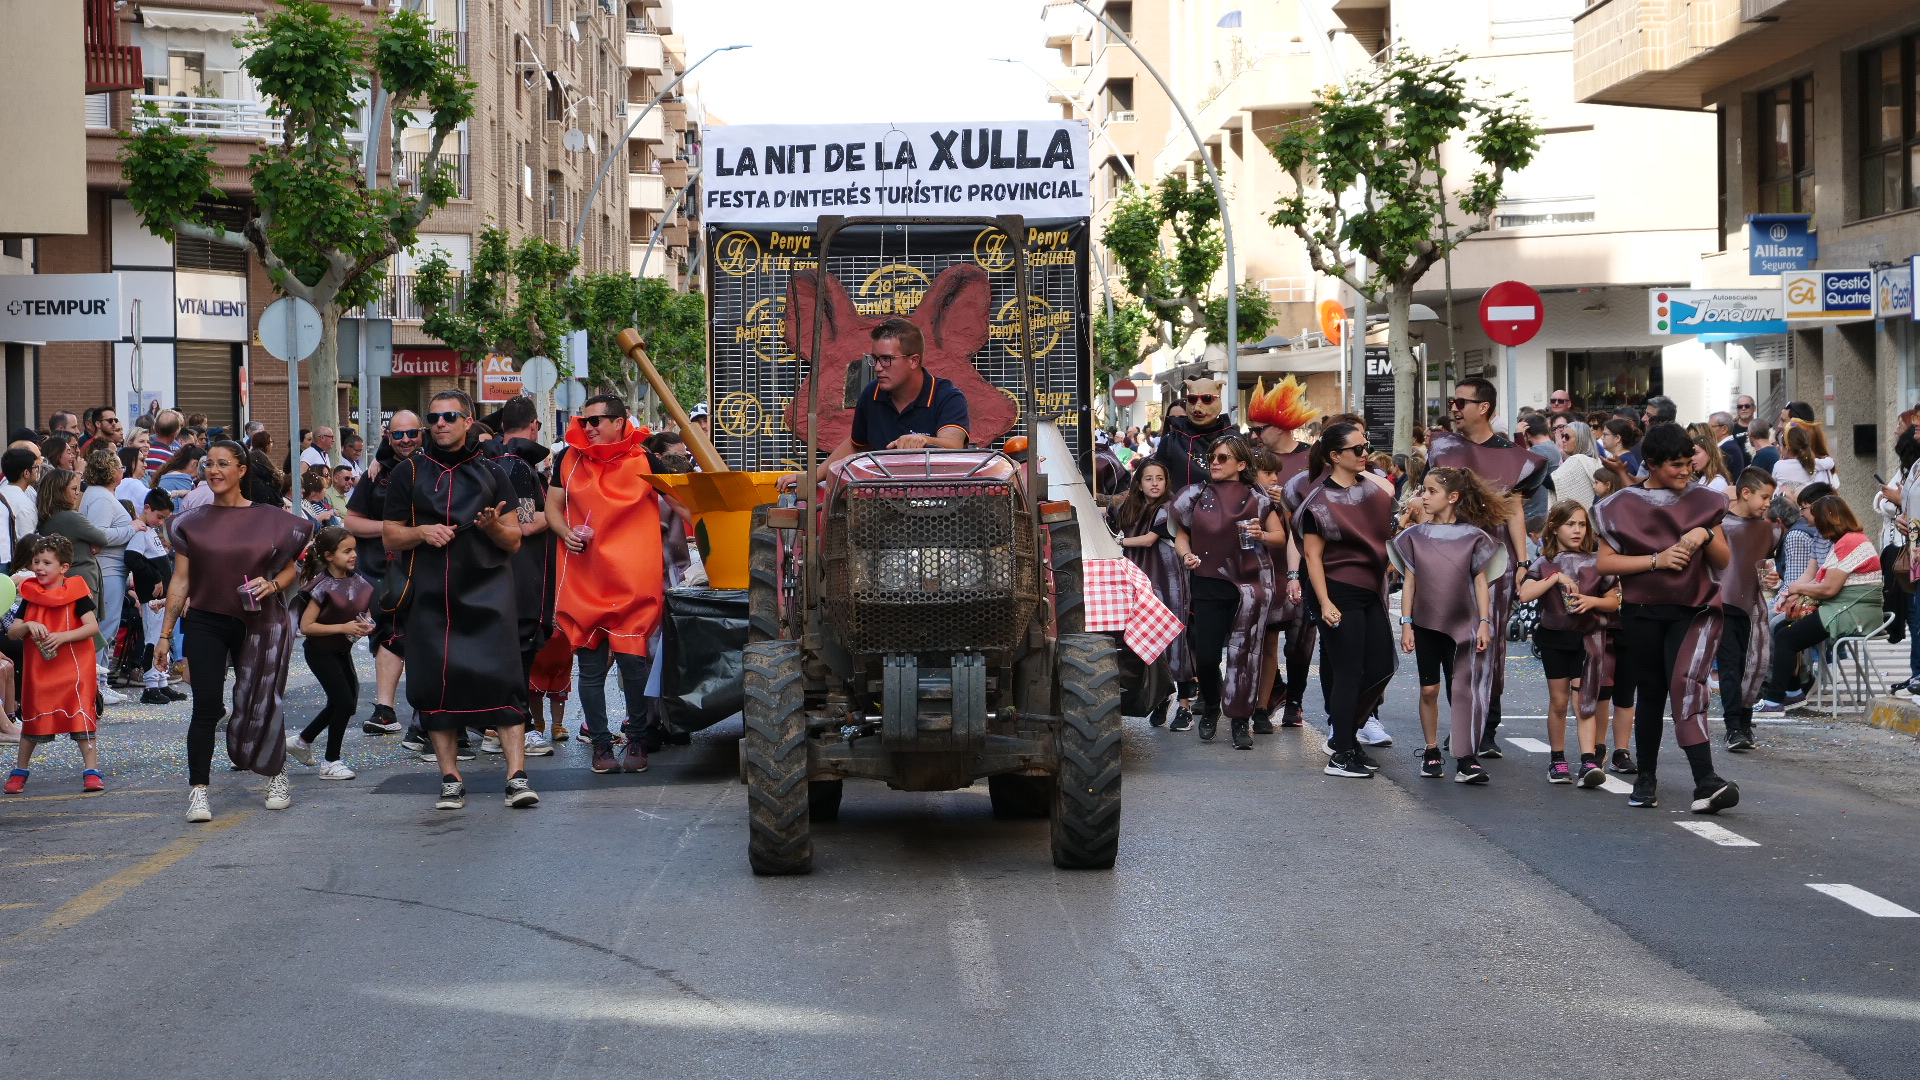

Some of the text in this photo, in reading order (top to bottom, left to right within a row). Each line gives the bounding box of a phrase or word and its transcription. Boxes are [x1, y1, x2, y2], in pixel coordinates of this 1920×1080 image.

[716, 128, 1075, 176] LA NIT DE LA XULLA
[707, 179, 1083, 208] FESTA D'INTERÉS TURÍSTIC PROVINCIAL
[769, 231, 811, 254] Penya
[1027, 227, 1069, 250] Penya
[1754, 244, 1804, 258] Allianz
[1762, 260, 1796, 272] Seguros
[1827, 275, 1871, 290] Gestió
[178, 298, 246, 317] VITALDENT
[1826, 291, 1871, 305] Quatre
[392, 352, 450, 374] Jaime
